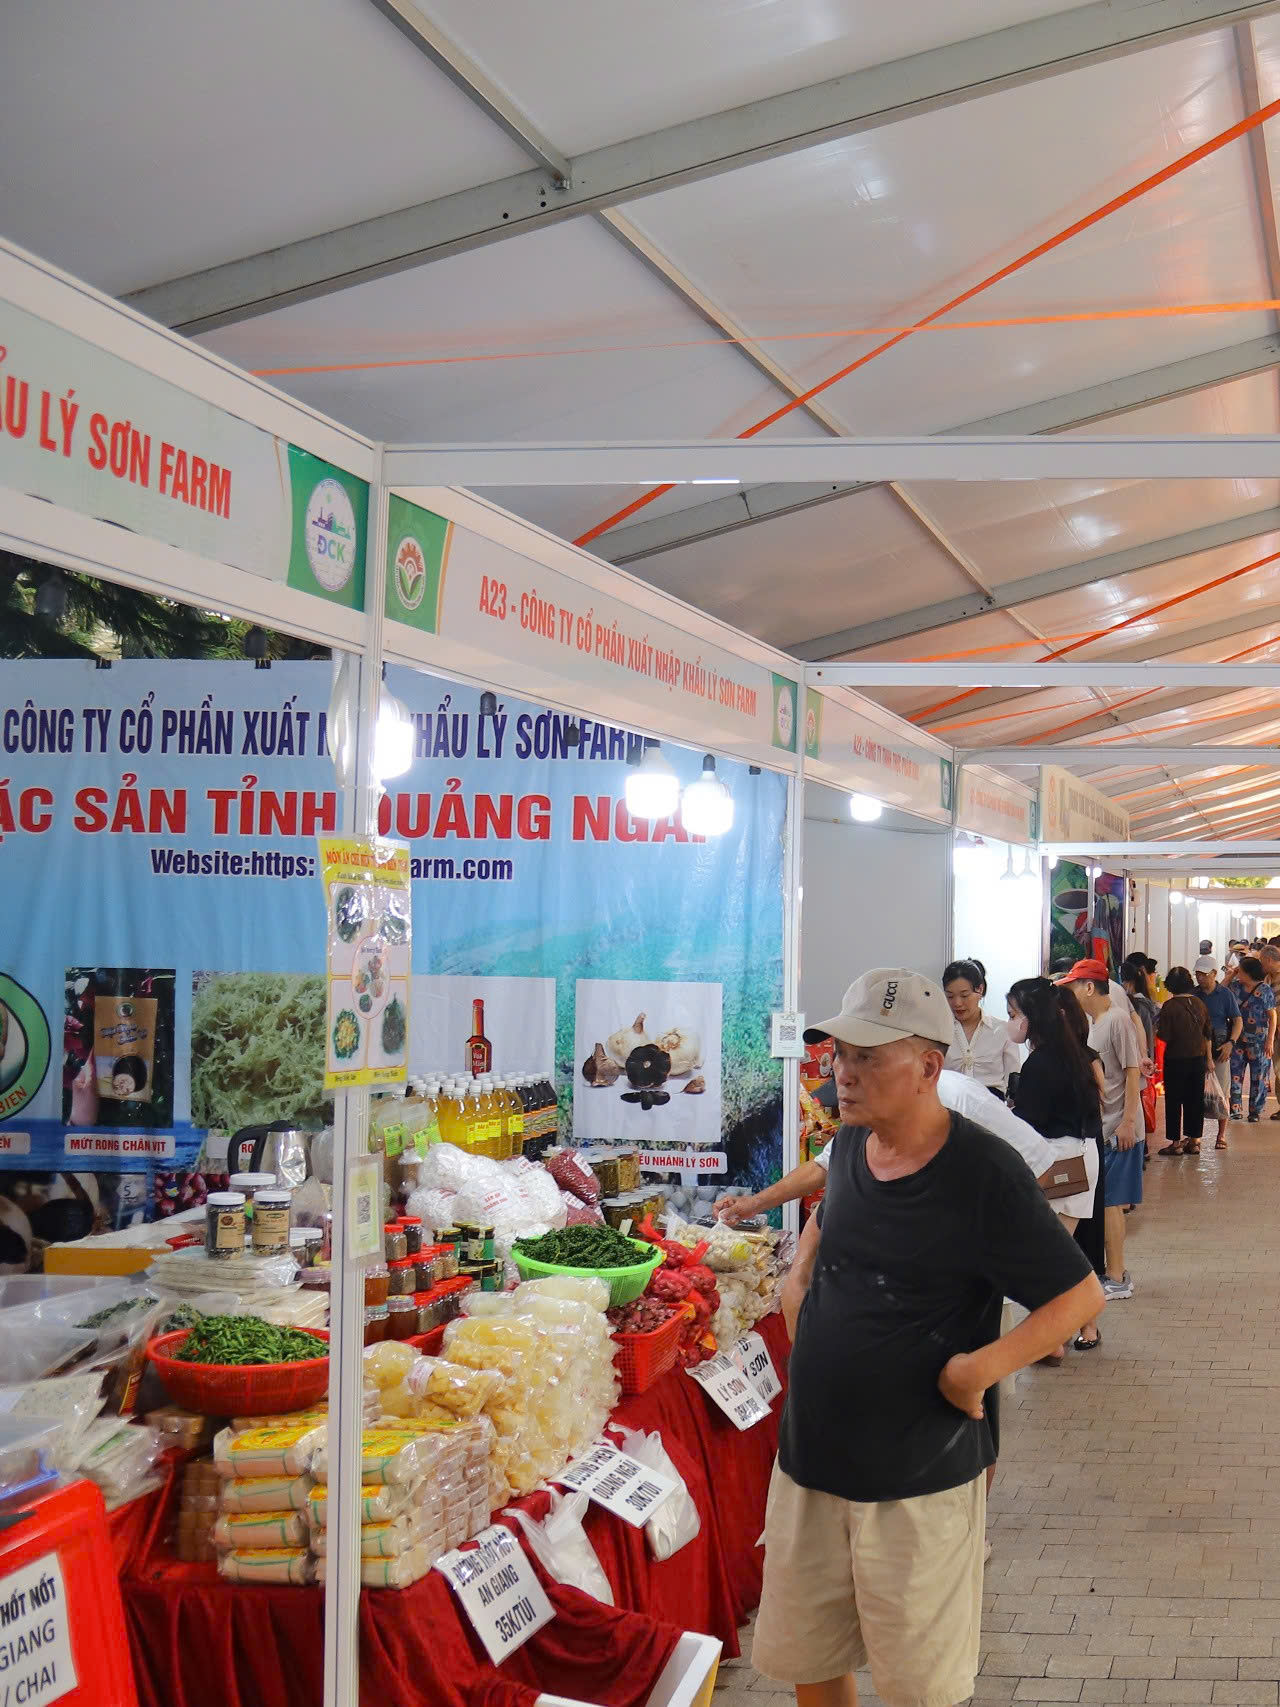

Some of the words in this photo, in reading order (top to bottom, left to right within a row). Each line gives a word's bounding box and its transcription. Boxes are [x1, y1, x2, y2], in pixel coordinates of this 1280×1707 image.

[40, 388, 80, 458] LÝ
[87, 412, 151, 488] SƠN
[159, 442, 232, 520] FARM
[479, 575, 507, 620] A23
[520, 588, 555, 640] CÔNG
[559, 608, 574, 646] TY
[576, 607, 594, 654] CỔ
[595, 619, 625, 667] PHẦN
[627, 633, 653, 677] XUẤT
[655, 651, 681, 692] NHẬP
[682, 655, 706, 697] KHẨU
[707, 667, 718, 701] LÝ
[719, 677, 736, 708] SƠN
[737, 683, 757, 717] FARM
[3, 699, 74, 753] CÔNG
[83, 708, 112, 753] TY
[119, 691, 155, 754] CỔ
[161, 694, 234, 756] PHẦN
[241, 695, 310, 757] XUẤT
[411, 694, 469, 758] HẨU
[515, 710, 569, 761] SƠN
[74, 773, 187, 833] SẢN
[207, 775, 336, 836] TỈNH
[883, 981, 899, 1009] GUCCI
[70, 1138, 94, 1150] MỨT
[95, 1140, 119, 1150] RONG
[123, 1138, 150, 1151] CHÂN
[151, 1140, 167, 1153] VỊT
[241, 1144, 254, 1153] RO
[652, 1155, 684, 1167] NHÁNH
[686, 1156, 696, 1168] LÝ
[699, 1157, 719, 1167] SƠN
[749, 1351, 769, 1377] SƠN
[717, 1383, 732, 1402] LÝ
[727, 1377, 747, 1396] SƠN
[625, 1480, 663, 1512] 30K/TÚI
[29, 1572, 57, 1611] NỐT
[478, 1583, 495, 1607] AN
[492, 1564, 519, 1597] GIANG
[495, 1596, 537, 1643] 35K/TÚI
[0, 1618, 55, 1672] GIANG
[15, 1661, 57, 1704] CHAI
